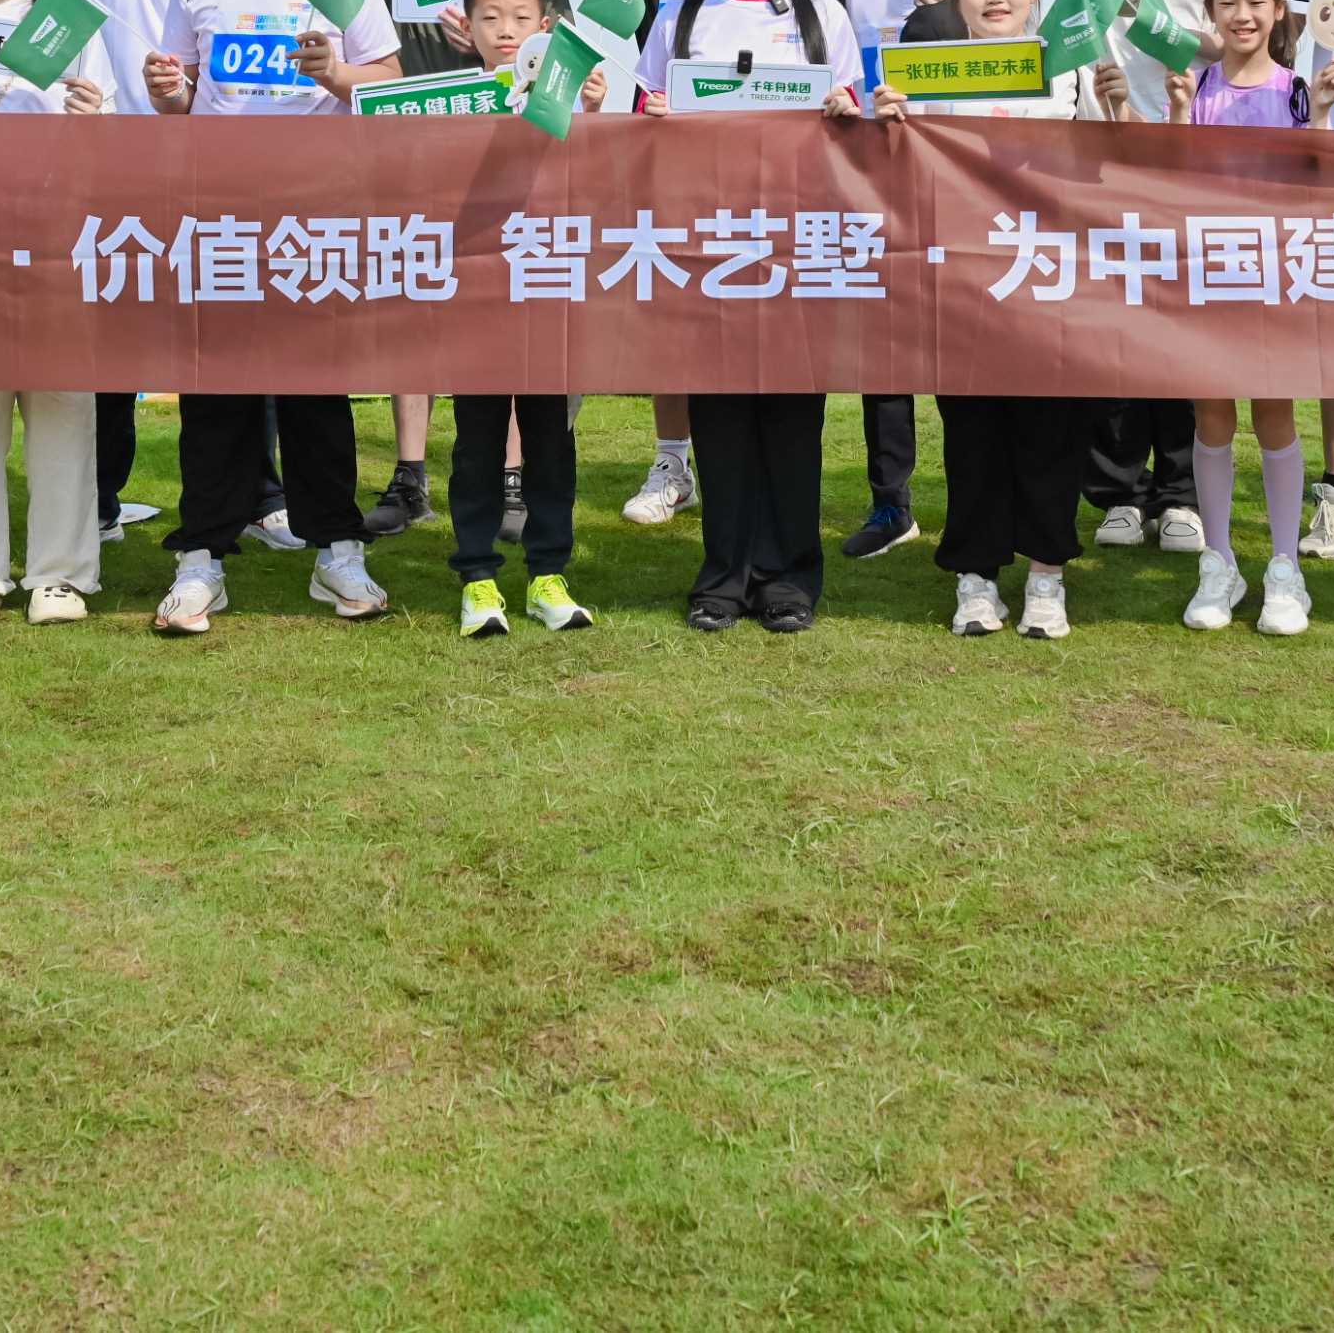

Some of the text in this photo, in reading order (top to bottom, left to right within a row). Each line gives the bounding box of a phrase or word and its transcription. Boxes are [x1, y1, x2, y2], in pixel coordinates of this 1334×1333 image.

[223, 42, 299, 76] 024
[887, 58, 1037, 80] 一张好板 装配未来
[697, 81, 734, 91] Treezo
[751, 80, 811, 94] 千年舟集团
[751, 93, 811, 103] TREEZO GROUP
